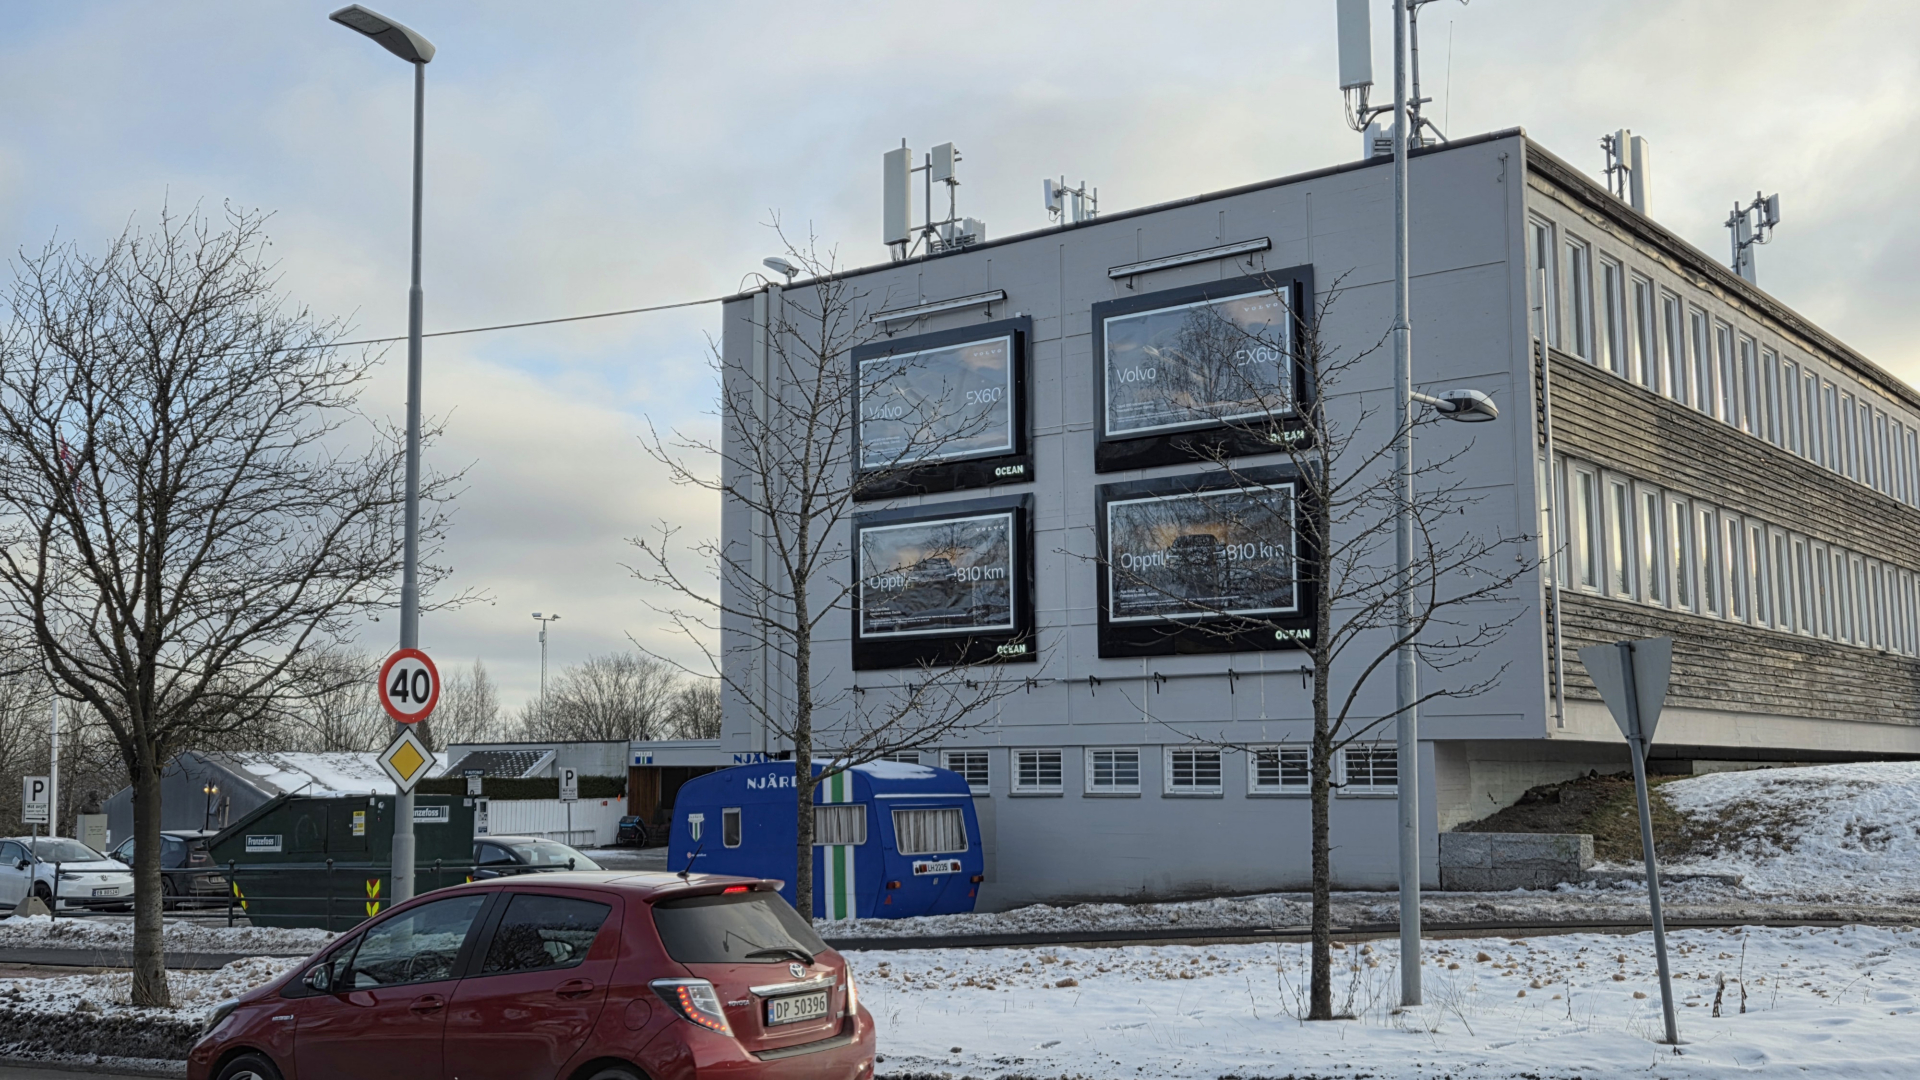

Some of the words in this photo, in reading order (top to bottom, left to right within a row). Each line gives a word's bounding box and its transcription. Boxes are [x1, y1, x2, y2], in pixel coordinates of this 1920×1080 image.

[1243, 302, 1279, 312] VOLVO
[973, 349, 1002, 357] VOLVO
[1236, 345, 1279, 366] EX60
[1116, 366, 1156, 383] Volvo
[966, 387, 1001, 406] EX60
[869, 405, 902, 420] Volvo
[995, 465, 1024, 477] OCEAN
[1226, 543, 1255, 560] 810
[1260, 541, 1285, 559] km
[1120, 551, 1165, 572] Opptil
[957, 566, 981, 582] 810
[984, 565, 1004, 580] km
[870, 573, 907, 592] Opptil
[1275, 628, 1311, 640] OCEAN
[997, 643, 1026, 655] OCEAN
[389, 668, 430, 704] 40
[565, 769, 574, 787] P
[32, 780, 44, 801] P
[248, 836, 274, 845] Franzefoss
[776, 1001, 790, 1019] DP
[794, 995, 825, 1016] 50396
